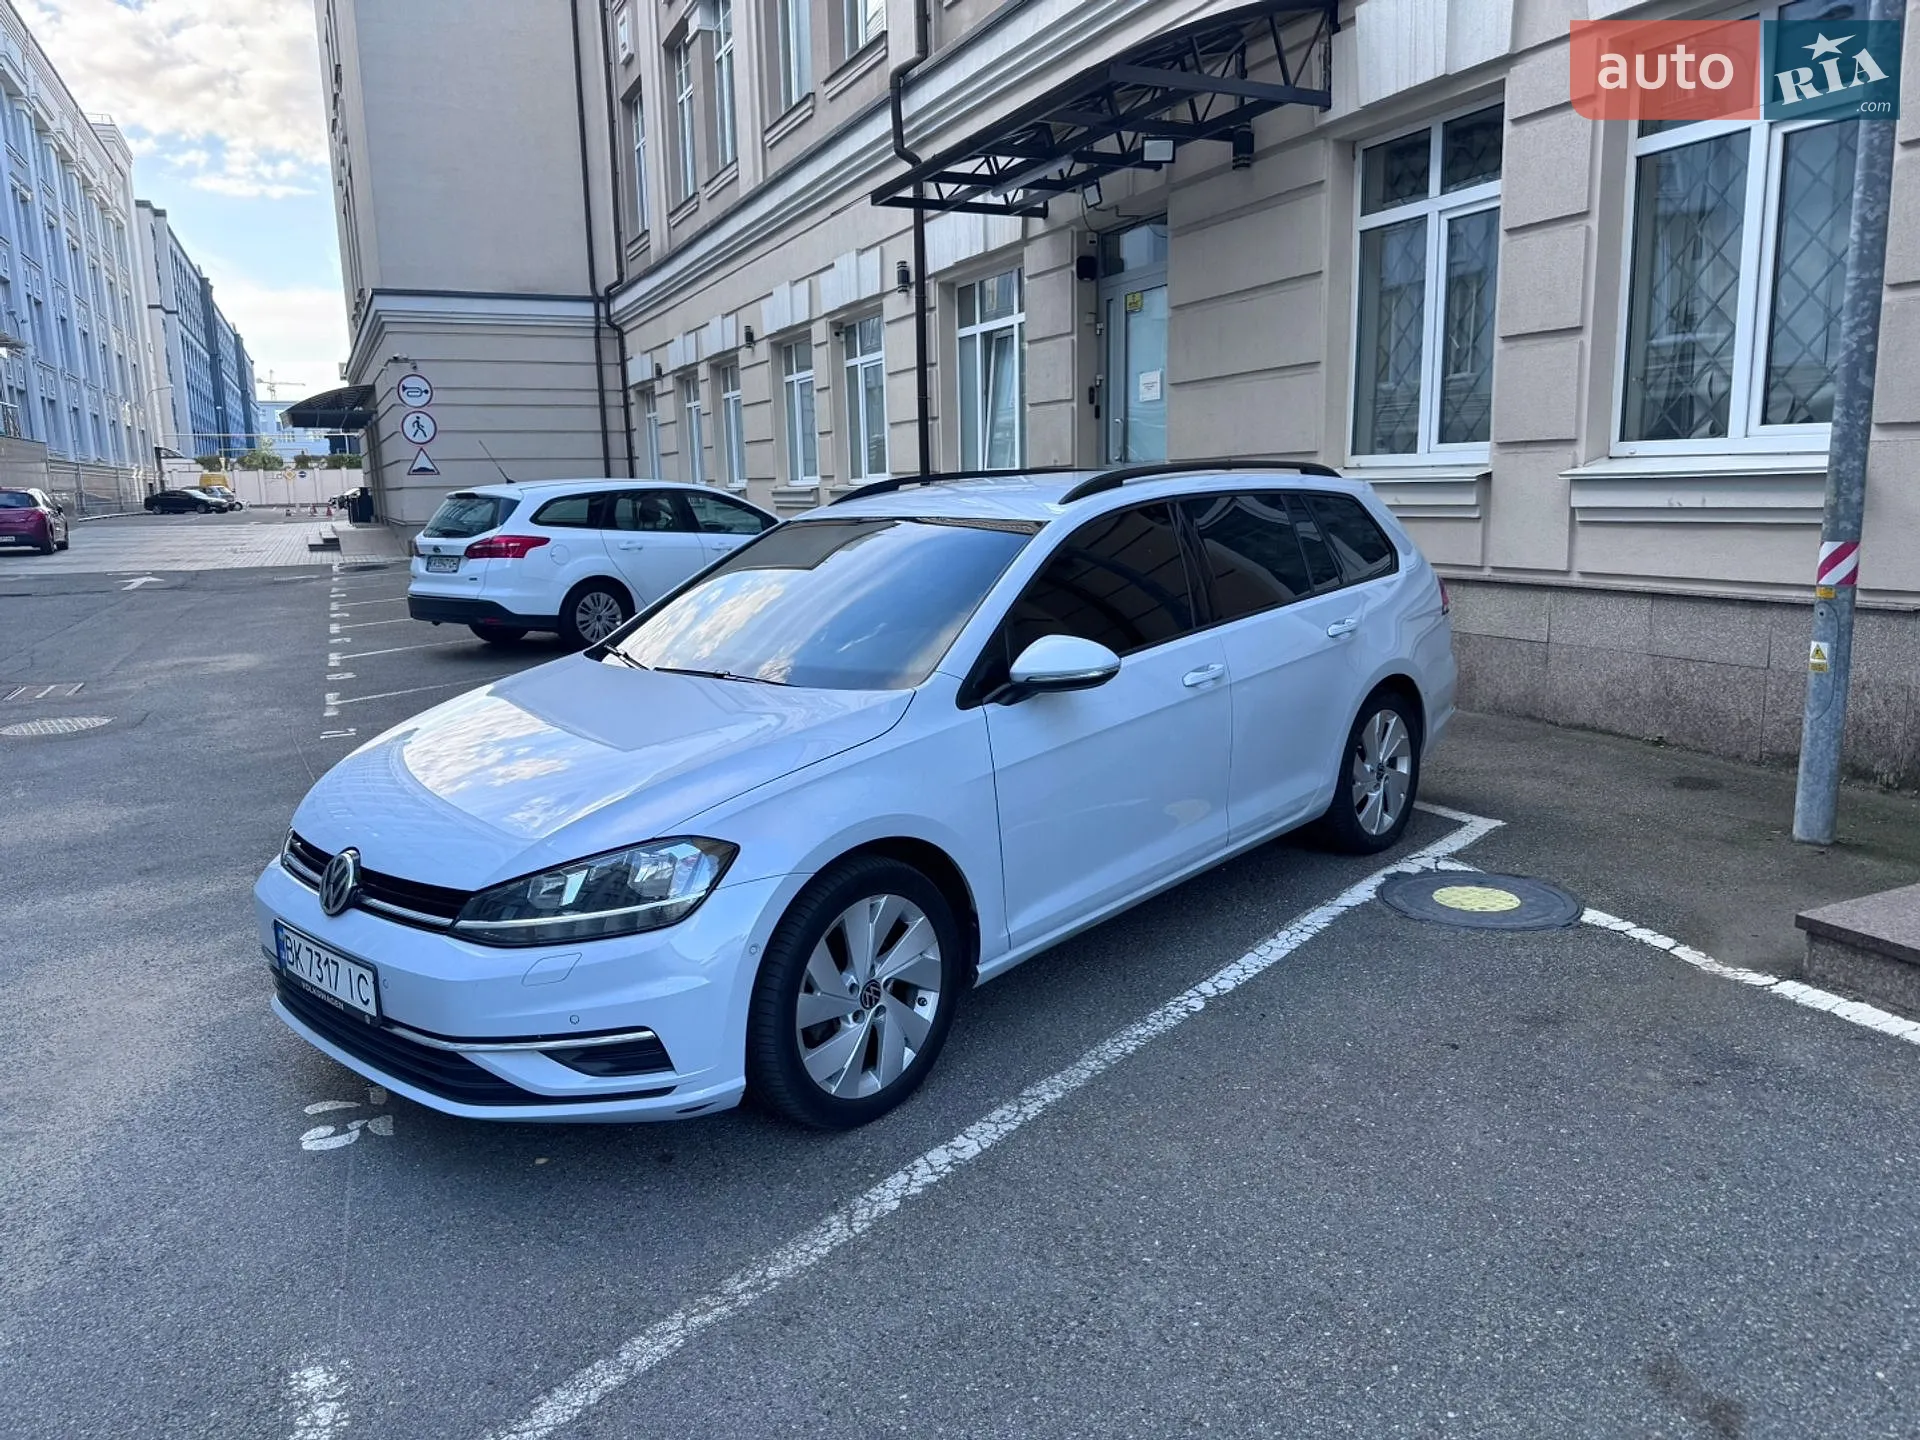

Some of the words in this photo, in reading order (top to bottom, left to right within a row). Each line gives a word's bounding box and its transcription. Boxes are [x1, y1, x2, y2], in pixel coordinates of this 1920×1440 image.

[285, 935, 305, 974] BK
[306, 947, 339, 992] 7317
[348, 967, 370, 1006] IC
[301, 981, 344, 1010] VOLKSWAGEN
